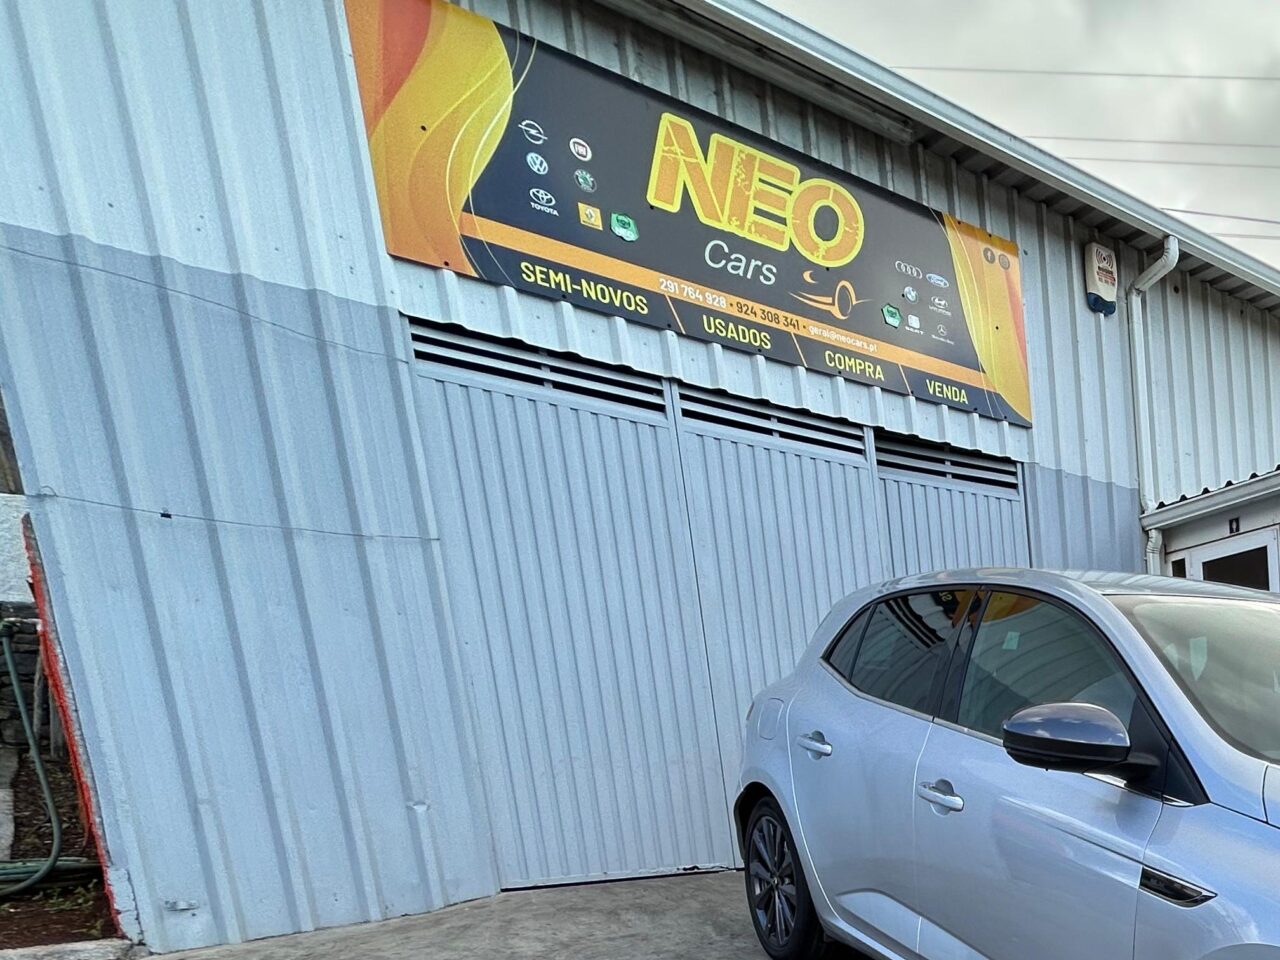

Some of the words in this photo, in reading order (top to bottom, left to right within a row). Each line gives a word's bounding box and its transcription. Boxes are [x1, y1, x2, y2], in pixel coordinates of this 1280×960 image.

[530, 201, 559, 217] TOYOTA
[646, 111, 865, 268] NEO
[703, 239, 778, 286] Cars
[520, 261, 649, 315] SEMI-NOVOS
[658, 277, 679, 294] 291
[681, 283, 703, 301] 764
[704, 290, 727, 309] 928
[736, 301, 757, 318] 924
[760, 307, 780, 325] 308
[783, 314, 801, 331] 341
[808, 325, 878, 353] geral@neocars.pl
[702, 314, 772, 350] USADOS
[824, 350, 885, 382] COMPRA
[925, 379, 969, 405] VENDA
